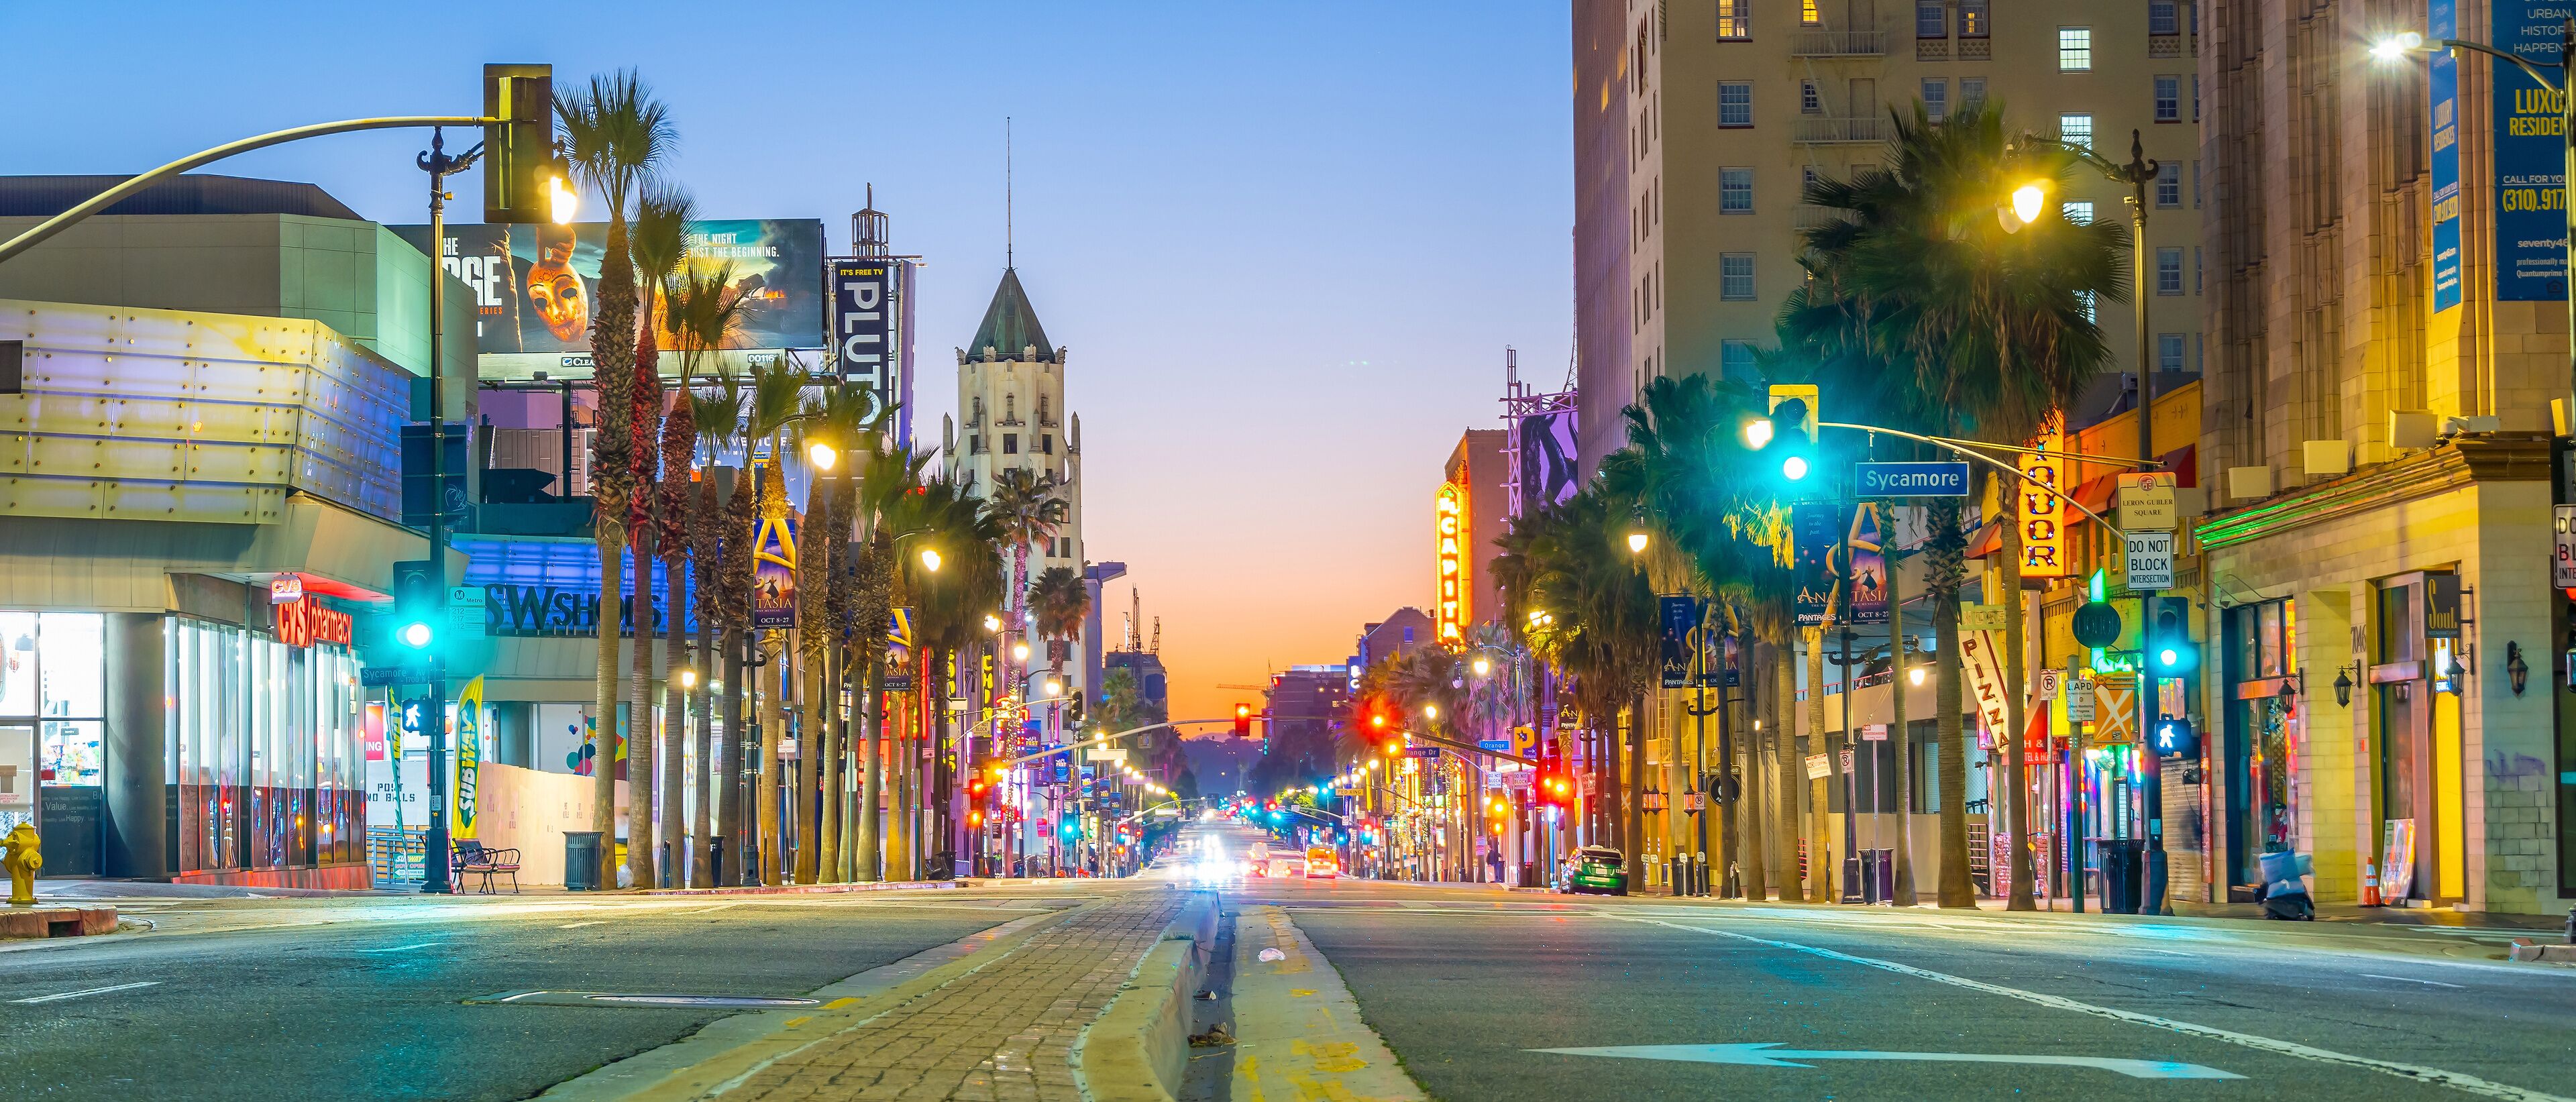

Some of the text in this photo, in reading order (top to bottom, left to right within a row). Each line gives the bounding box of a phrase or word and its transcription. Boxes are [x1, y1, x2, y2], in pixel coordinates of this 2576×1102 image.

[2527, 9, 2571, 19] URBAN
[2503, 175, 2527, 183] CALL
[2529, 175, 2548, 183] FOR
[712, 233, 737, 244] NIGHT
[443, 237, 459, 256] HE
[712, 247, 727, 258] THE
[732, 246, 780, 258] BEGINNING.
[1866, 470, 1960, 491] Sycamore
[2129, 540, 2169, 553] DO NOT
[2131, 558, 2168, 571] BLOCK
[2130, 575, 2169, 584] INTERSECTION
[272, 580, 300, 594] CVS
[755, 598, 793, 608] TASIA
[1798, 614, 1837, 622] PANTAGES
[364, 669, 407, 680] Sycamore
[2067, 683, 2092, 691] LAPD
[1962, 639, 2008, 749] PIZZA
